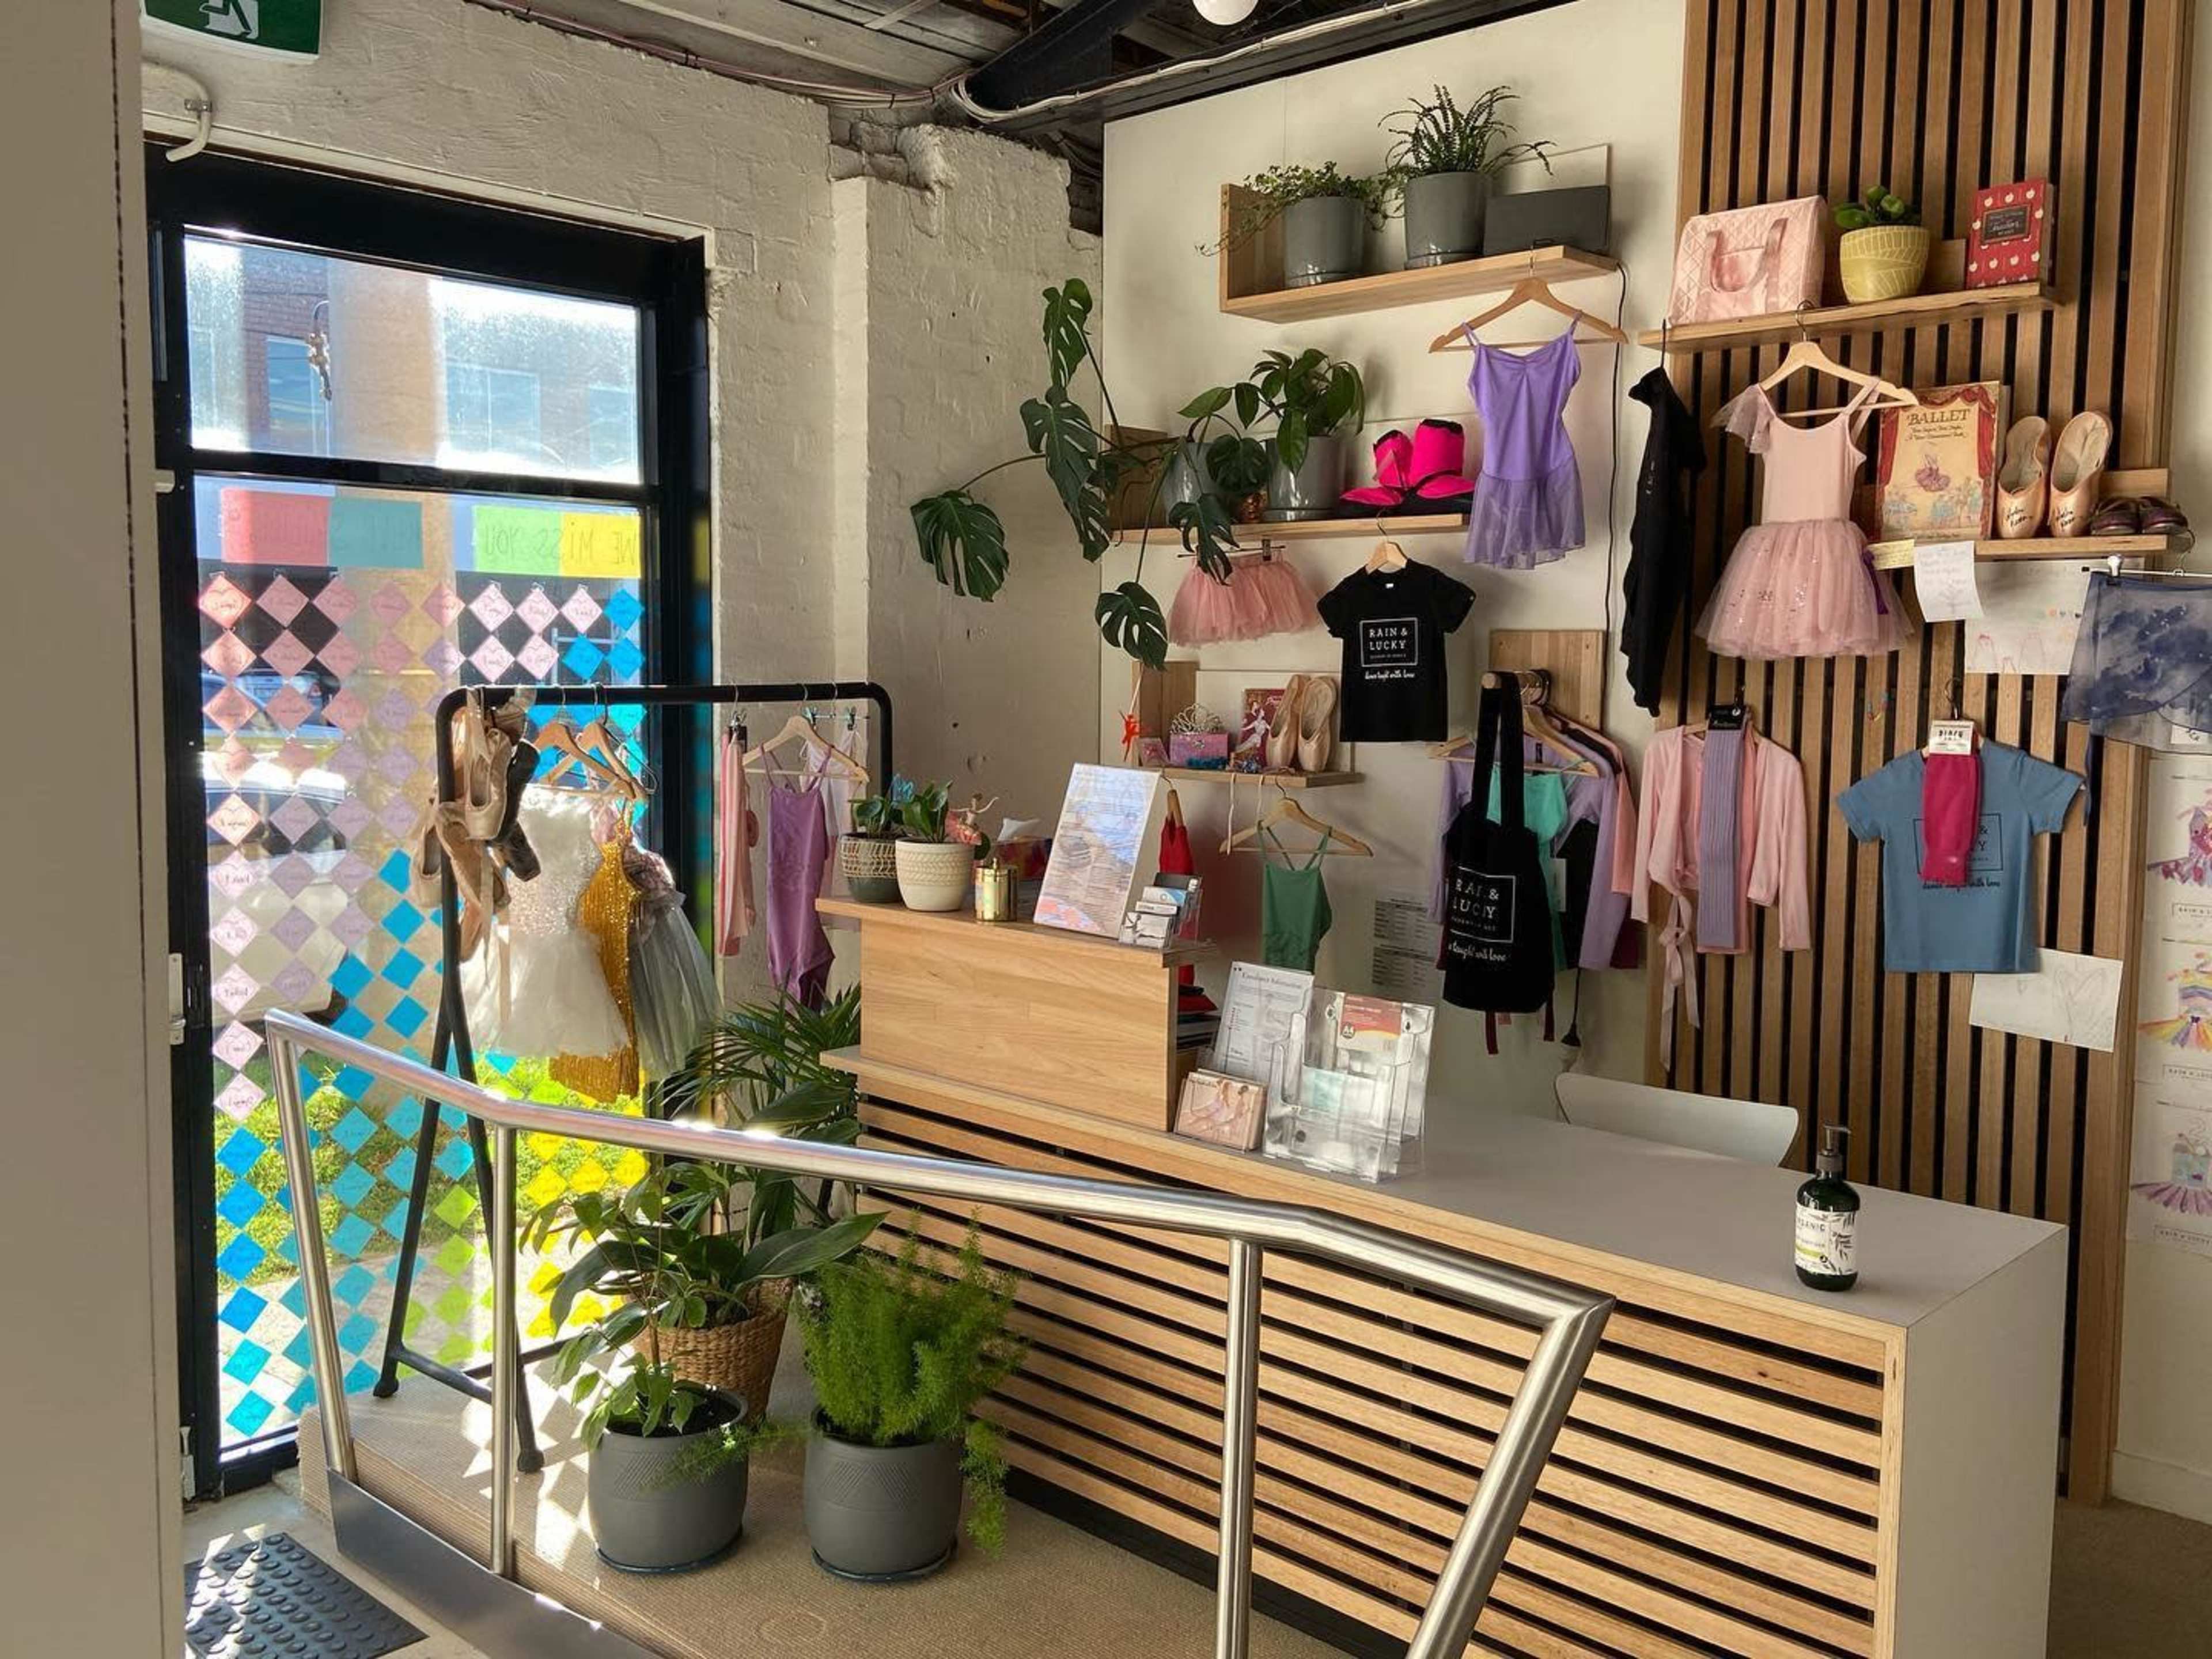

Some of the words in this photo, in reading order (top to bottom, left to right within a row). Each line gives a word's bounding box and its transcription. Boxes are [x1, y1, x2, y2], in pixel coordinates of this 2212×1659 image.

[1907, 408, 1971, 426] BALLET
[1369, 627, 1397, 638] RAIN
[1400, 627, 1408, 637] &
[1369, 639, 1406, 651] LUCKY
[1488, 888, 1499, 900] &
[1488, 947, 1507, 963] love
